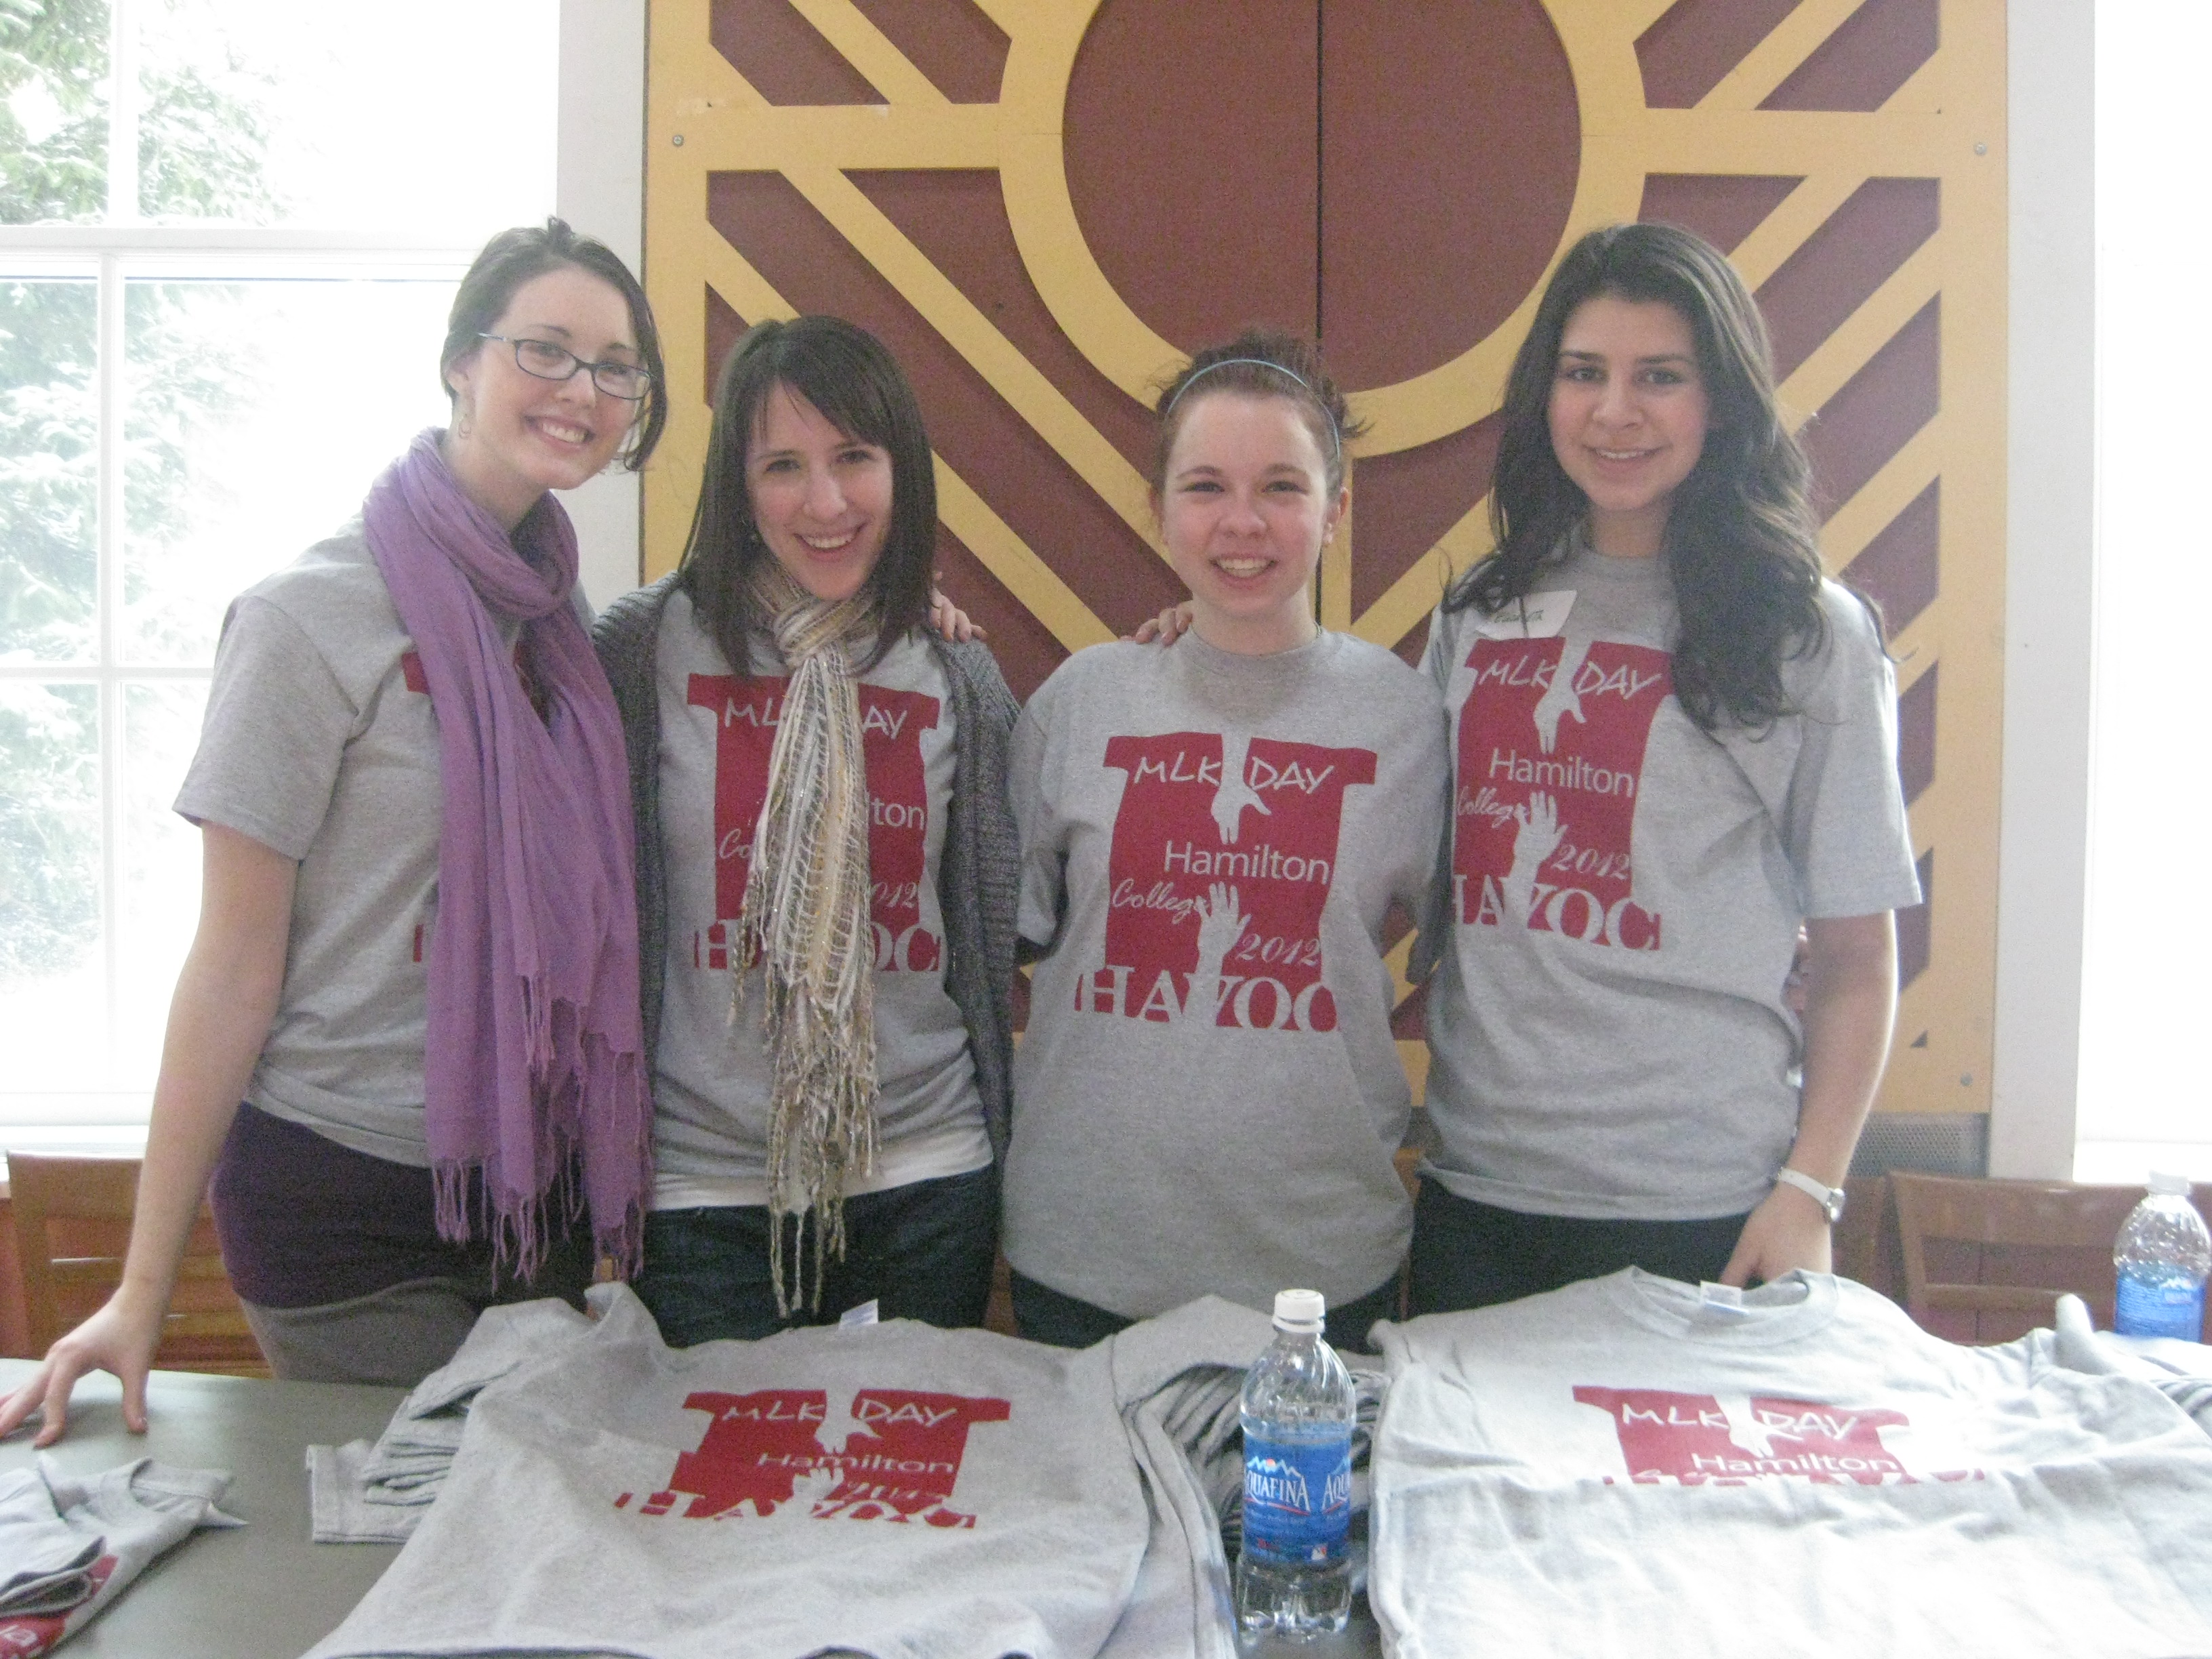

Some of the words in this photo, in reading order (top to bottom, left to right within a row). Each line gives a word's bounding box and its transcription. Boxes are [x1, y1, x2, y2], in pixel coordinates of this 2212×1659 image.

[1479, 655, 1558, 689] MLK
[1576, 661, 1662, 699] DAY
[724, 697, 779, 728] ML
[862, 705, 907, 739] AY
[1134, 752, 1221, 787] MLK
[1250, 756, 1334, 794] DAY
[1489, 748, 1635, 798] Hamilton
[1164, 840, 1330, 885] Hamilton
[1551, 844, 1631, 880] 2012
[1236, 933, 1320, 967] 2012
[722, 1402, 826, 1422] MLK
[857, 1398, 957, 1427] DAY
[1622, 1403, 1729, 1429] MLK
[1757, 1408, 1858, 1439] DAY
[757, 1452, 954, 1473] Hamilton
[1692, 1452, 1898, 1473] Hamilton
